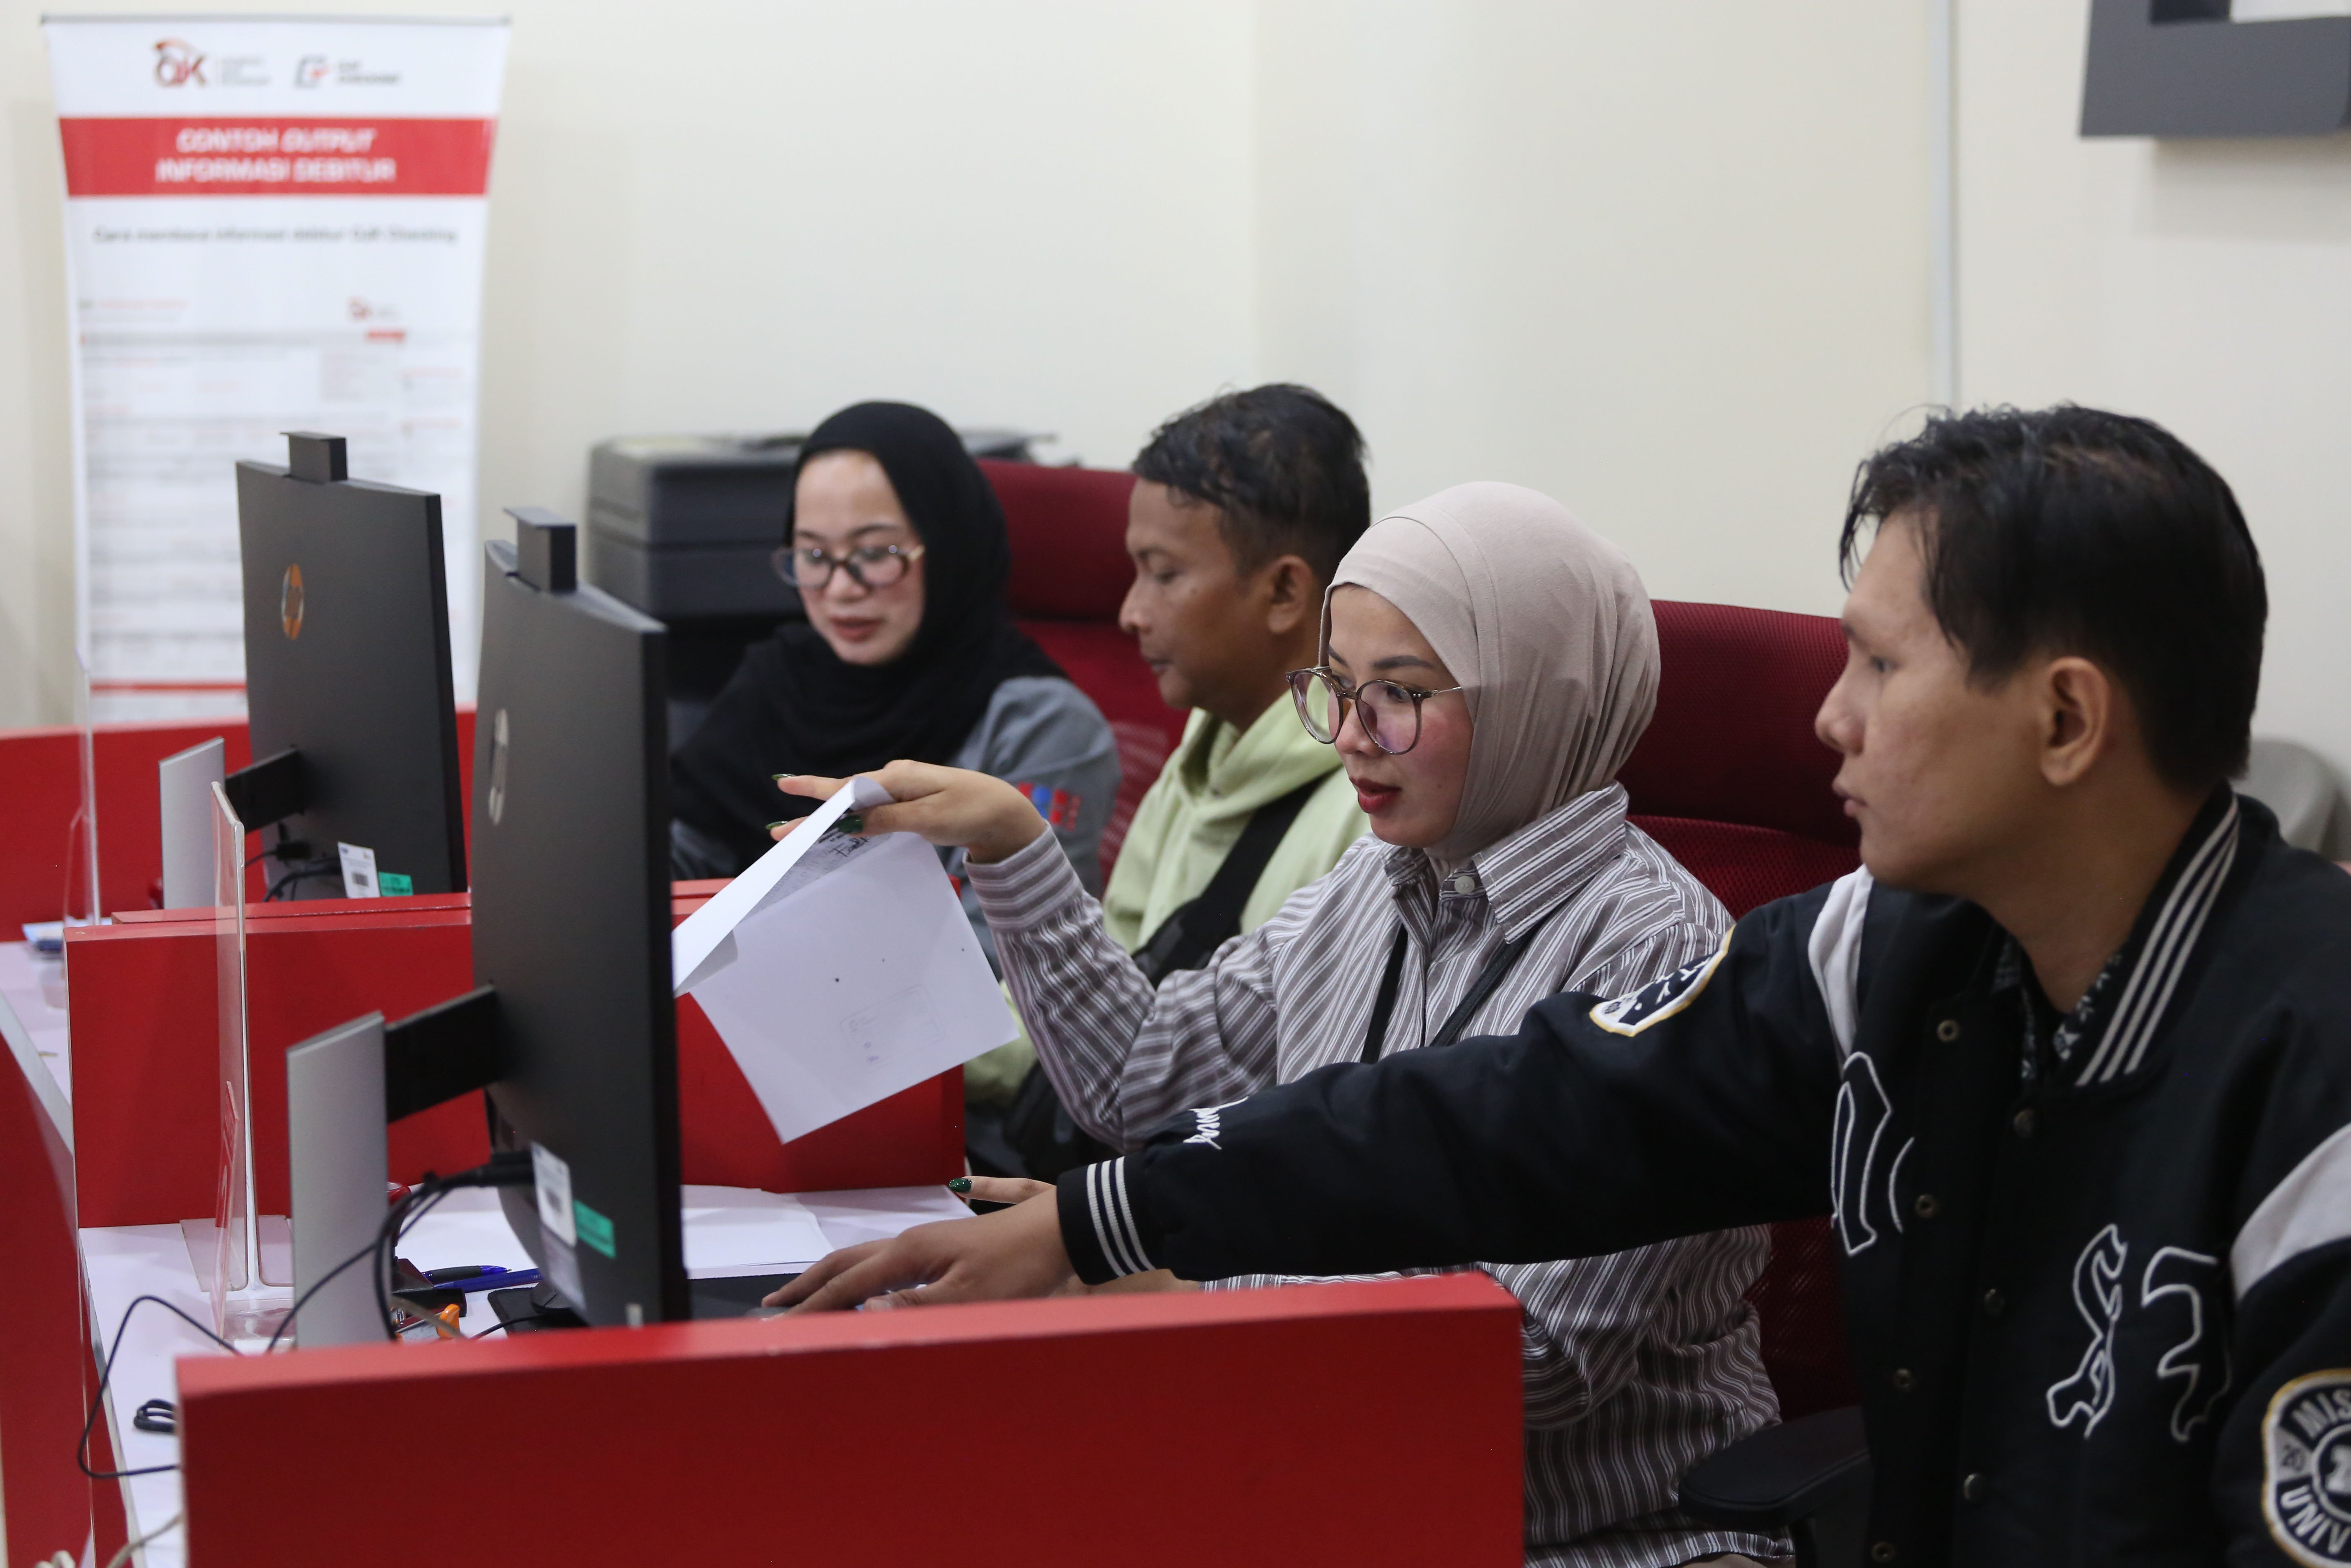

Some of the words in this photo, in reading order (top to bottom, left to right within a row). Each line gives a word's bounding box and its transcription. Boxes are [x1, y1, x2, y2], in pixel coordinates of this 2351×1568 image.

[177, 128, 278, 151] CONTOH
[282, 128, 376, 151] OUTPUT
[156, 158, 290, 181] INFORMASI
[293, 158, 396, 181] DEBITUR
[2281, 1484, 2351, 1555] UNIV
